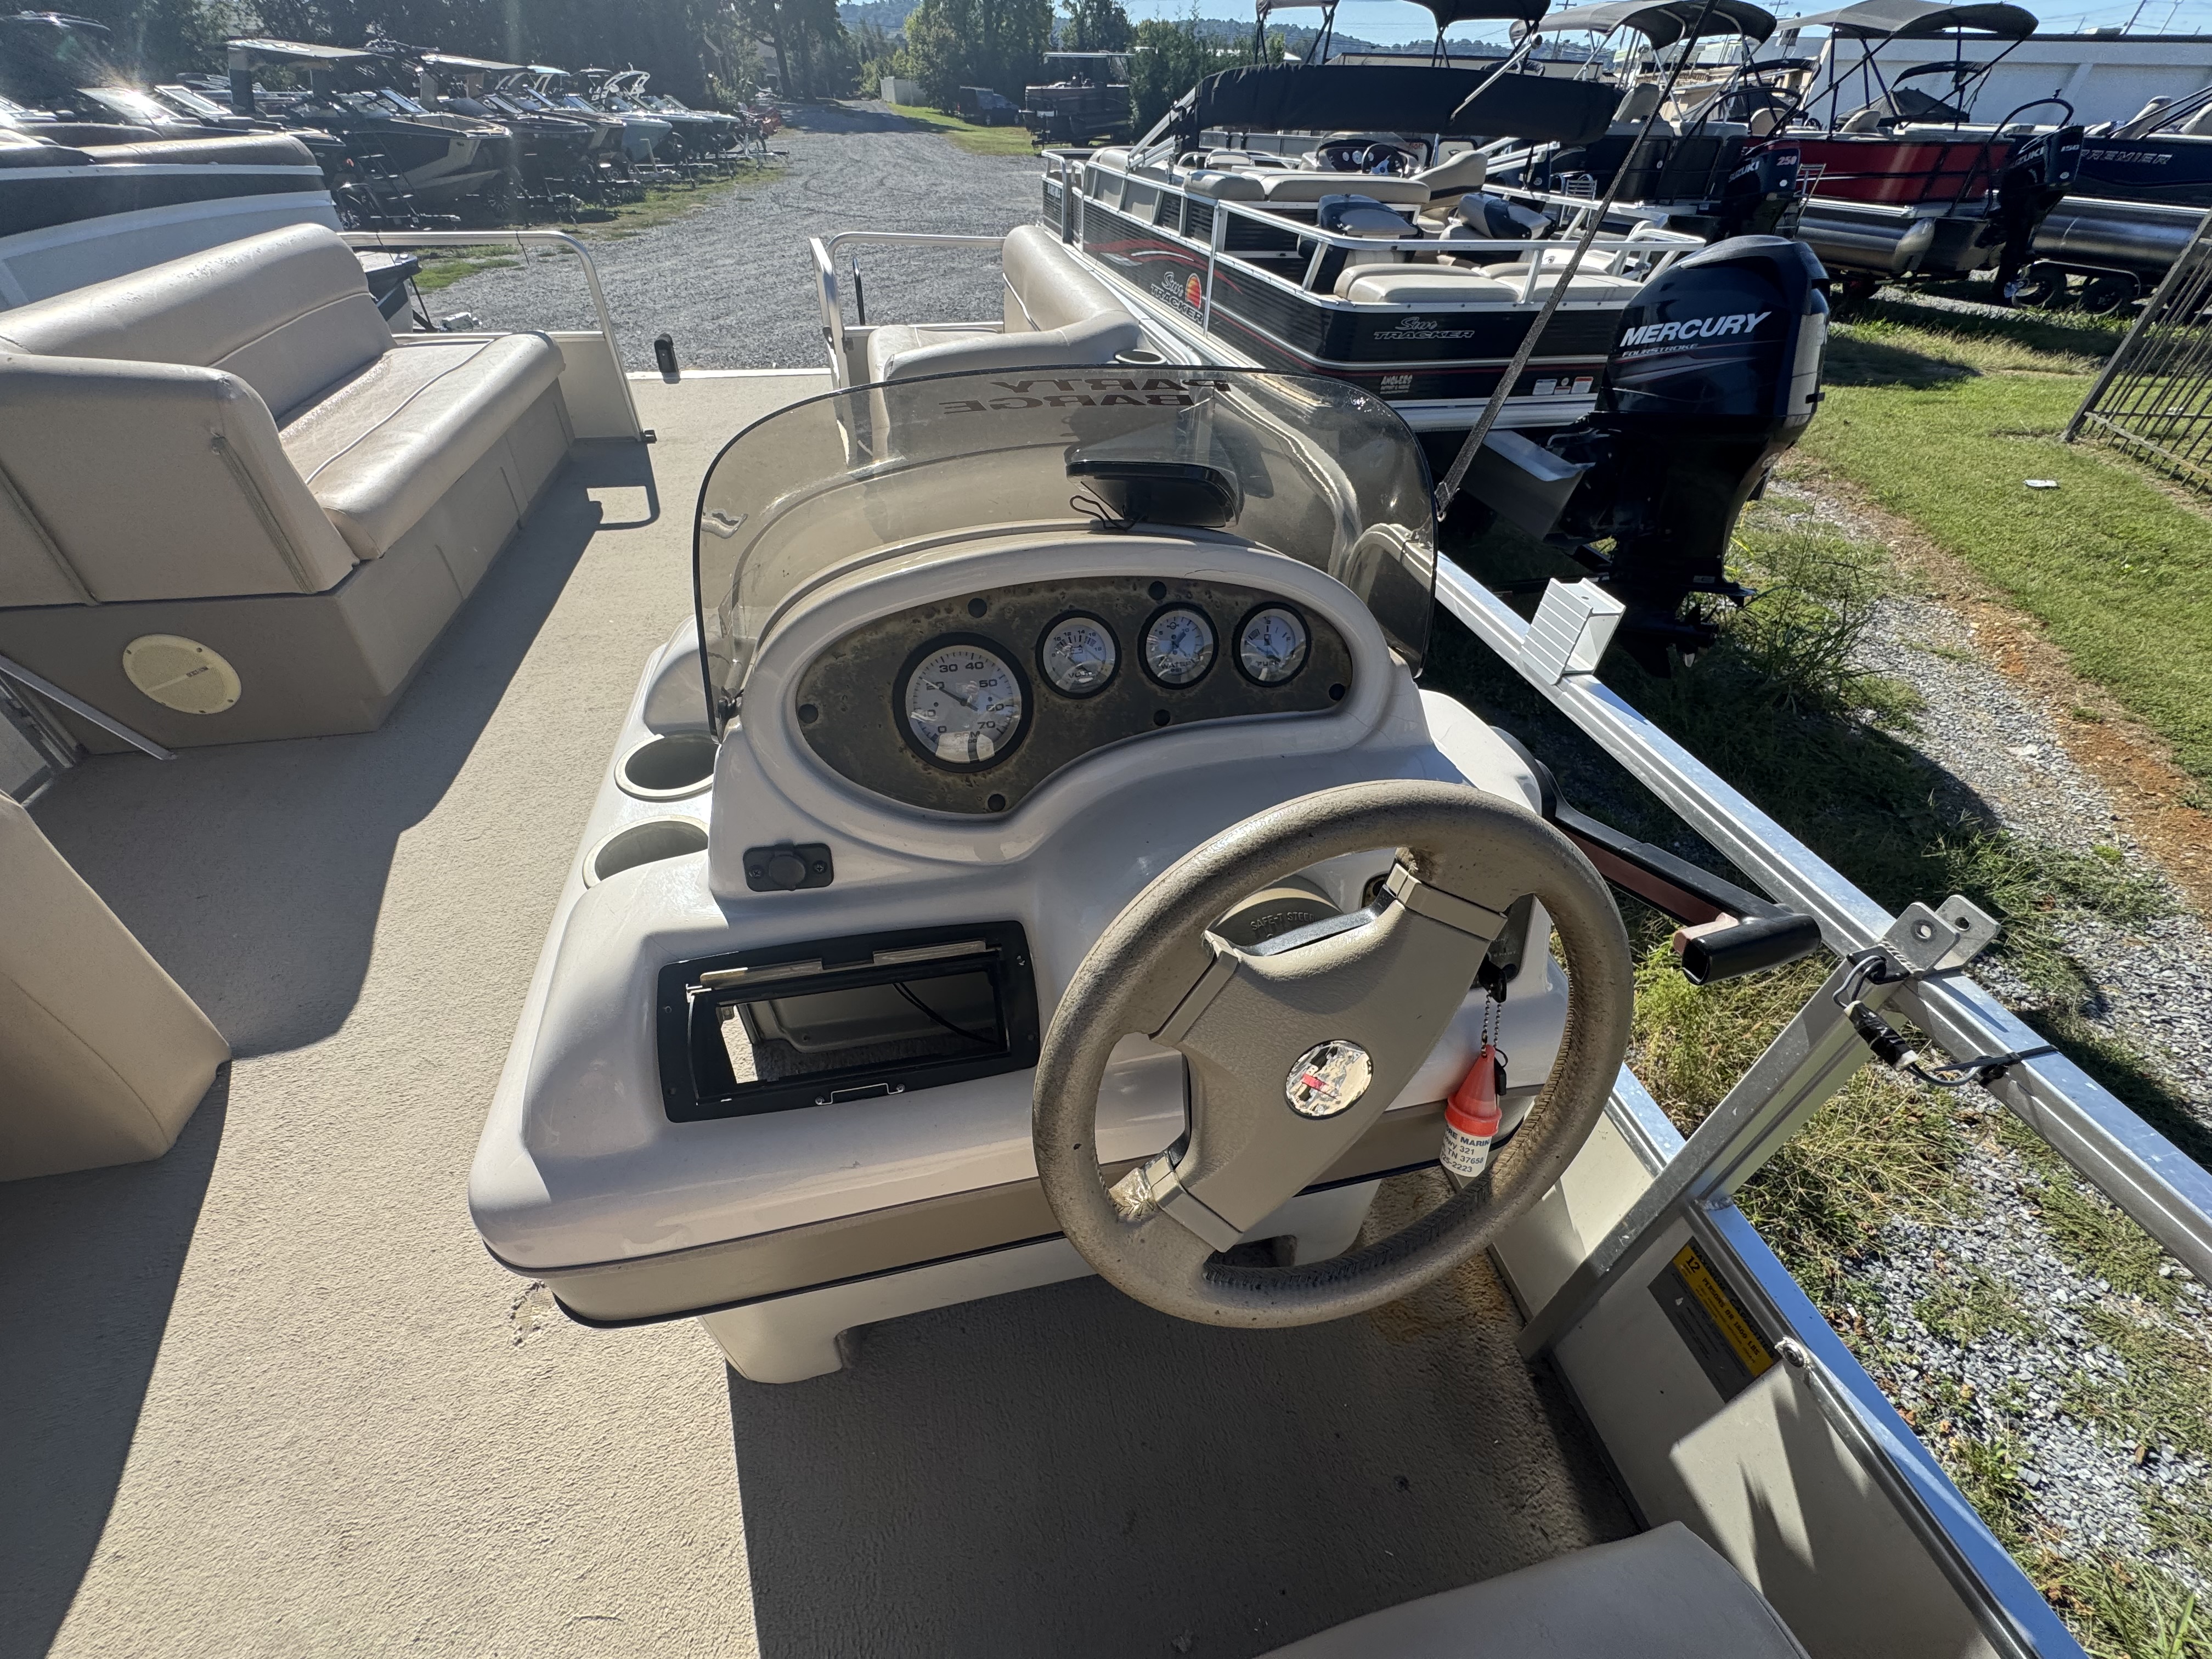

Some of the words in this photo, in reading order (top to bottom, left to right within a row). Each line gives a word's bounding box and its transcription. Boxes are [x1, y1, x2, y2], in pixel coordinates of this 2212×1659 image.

[1776, 156, 1797, 166] 250
[2080, 149, 2173, 165] PREMIER
[1728, 161, 1760, 183] SUZUKI
[1151, 284, 1204, 323] TRACKER
[1374, 330, 1475, 340] TRACKER
[1620, 312, 1772, 347] MERCURY
[1622, 343, 1699, 358] FOURSTROKE
[939, 664, 958, 673] 30
[965, 662, 984, 670] 40
[926, 681, 945, 690] 20
[979, 679, 998, 687] 50
[986, 703, 1005, 712] 60
[977, 721, 996, 729] 70
[1250, 913, 1283, 930] SAFE-T
[1445, 1135, 1458, 1150] Hwy
[1459, 1146, 1475, 1155] 321
[1441, 1152, 1472, 1173] 725-2223
[1448, 1148, 1458, 1159] TN
[1460, 1155, 1484, 1164] 37658
[1685, 1254, 1701, 1273] 12
[1691, 1245, 1726, 1291] MAXIMUM
[1702, 1277, 1725, 1308] PERSONS
[1724, 1308, 1734, 1320] OR
[1747, 1340, 1760, 1356] LBS
